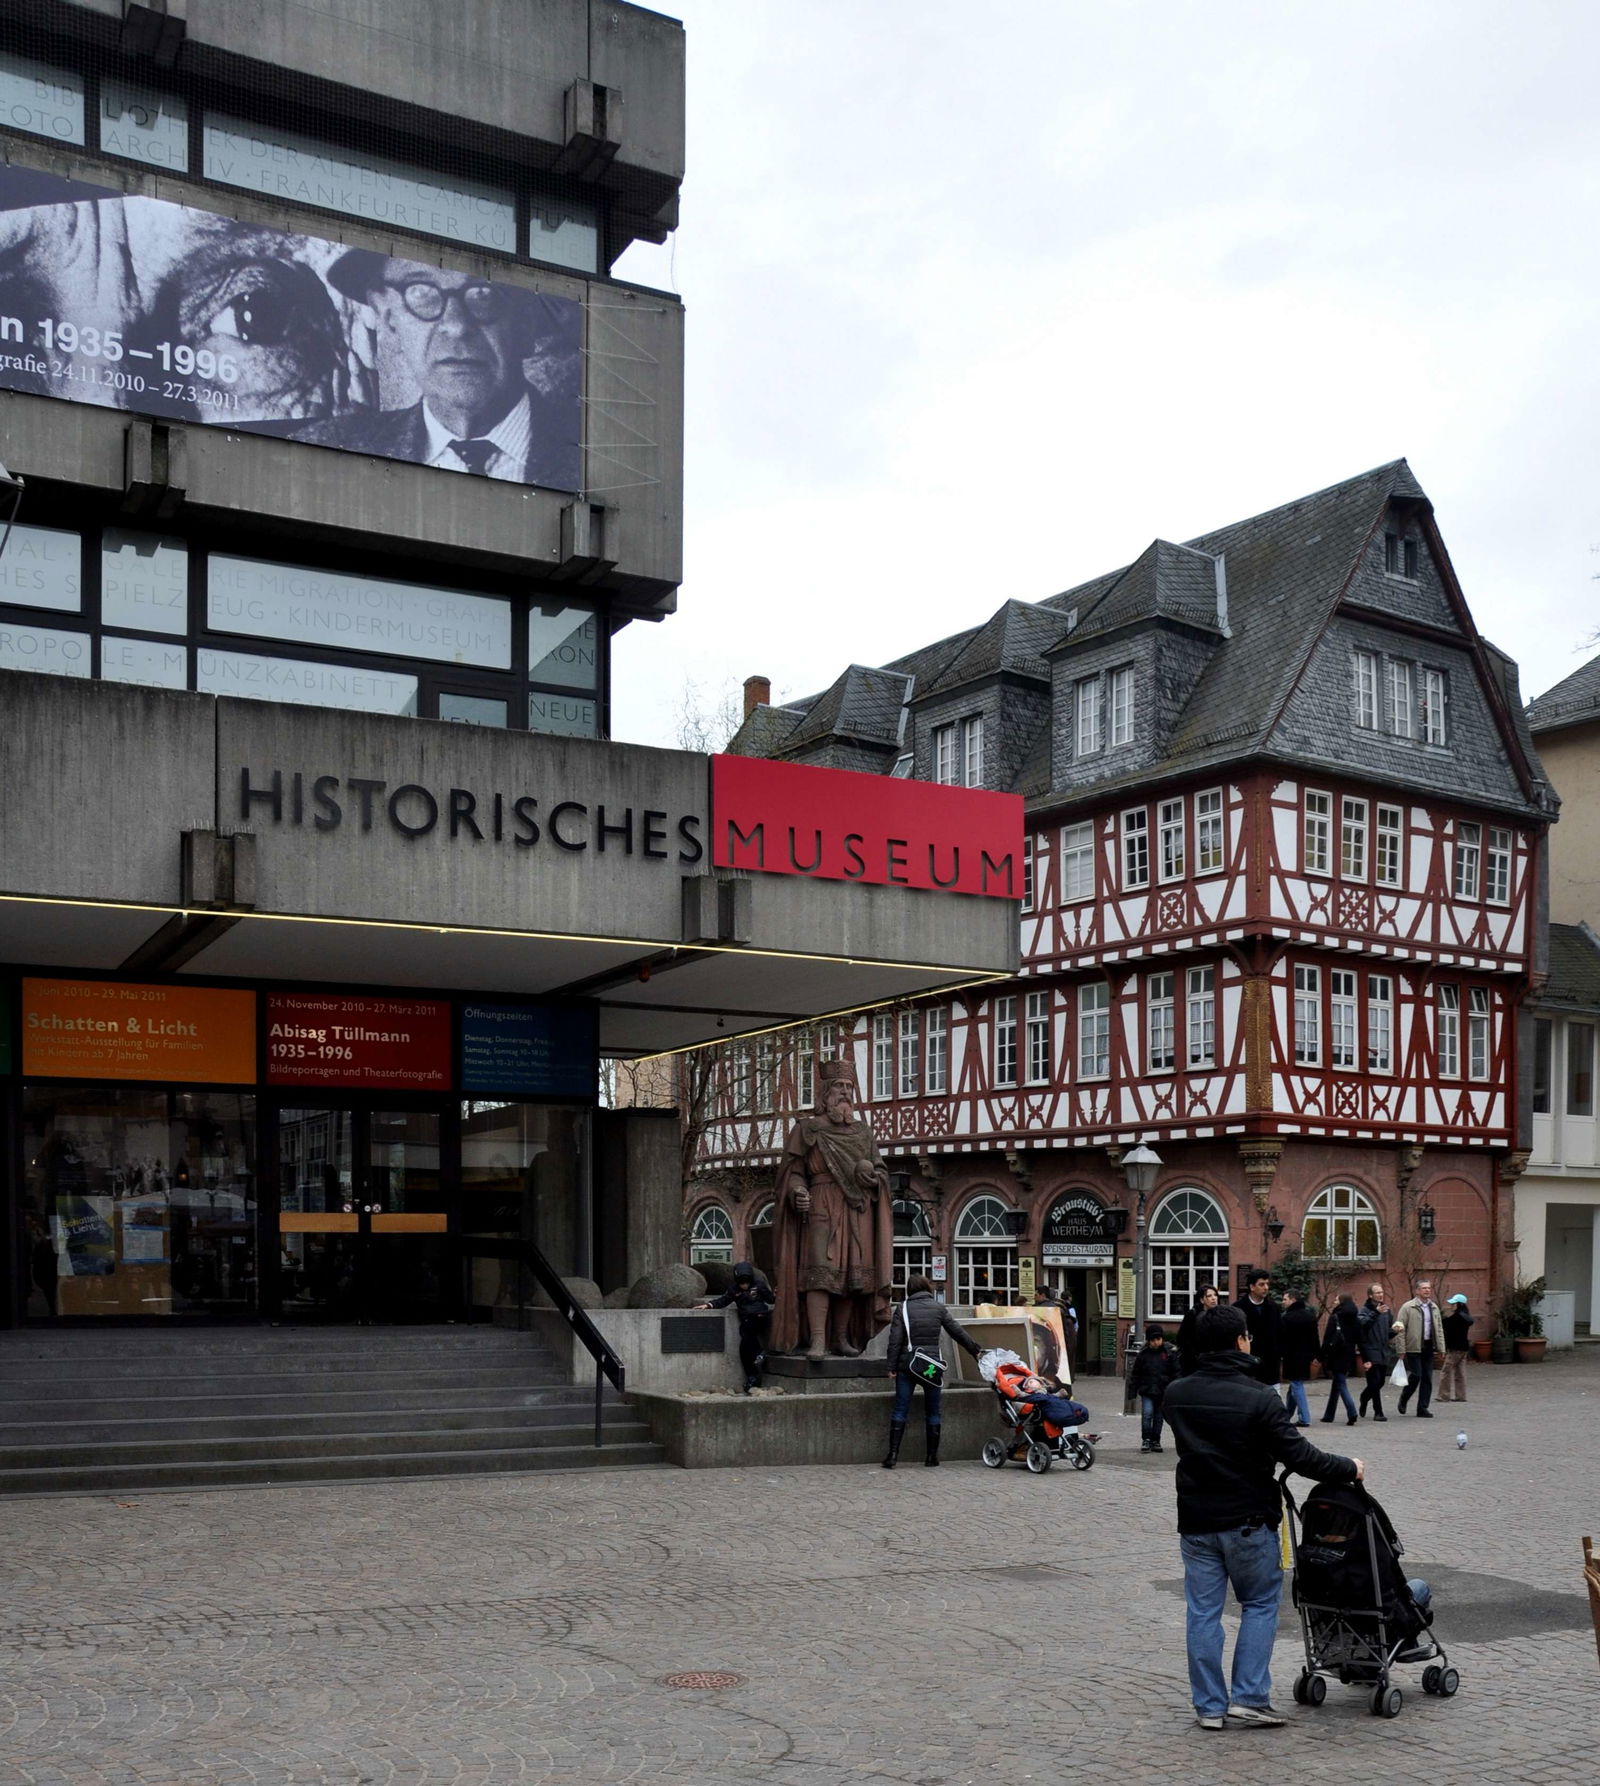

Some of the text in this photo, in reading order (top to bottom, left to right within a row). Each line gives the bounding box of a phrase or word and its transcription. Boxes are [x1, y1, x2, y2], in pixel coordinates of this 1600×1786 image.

[250, 137, 300, 167] DER
[311, 154, 392, 191] ALTEN
[260, 170, 460, 236] FRANKFURTER
[51, 360, 146, 392] 24.11.2010
[162, 380, 239, 410] 27.3.2011
[260, 573, 402, 611] MIGRATION
[289, 604, 491, 650] KINDERMUSEUM
[529, 699, 593, 725] NEUE
[240, 766, 1014, 896] HISTORISCHES MUSEUM
[63, 986, 91, 998] 2010
[101, 987, 118, 999] 29.
[120, 989, 139, 1000] Mai
[141, 990, 167, 1002] 2011
[269, 997, 285, 1008] 24.
[286, 999, 339, 1011] November
[341, 1001, 365, 1012] 2010
[389, 1003, 412, 1015] März
[415, 1005, 437, 1016] 2011
[464, 1006, 534, 1022] Öffnungszeiten
[27, 1012, 198, 1036] Schatten & Licht
[269, 1022, 411, 1043] Abisag Tüllmann
[162, 1039, 204, 1050] Familien
[116, 1049, 149, 1061] Jahren
[269, 1063, 444, 1081] Bildreportagen und Theaterfotografie
[1051, 1225, 1105, 1238] WERTHEYM
[1067, 1217, 1088, 1226] HAUS
[1043, 1244, 1113, 1254] SPEISERESTAURANT
